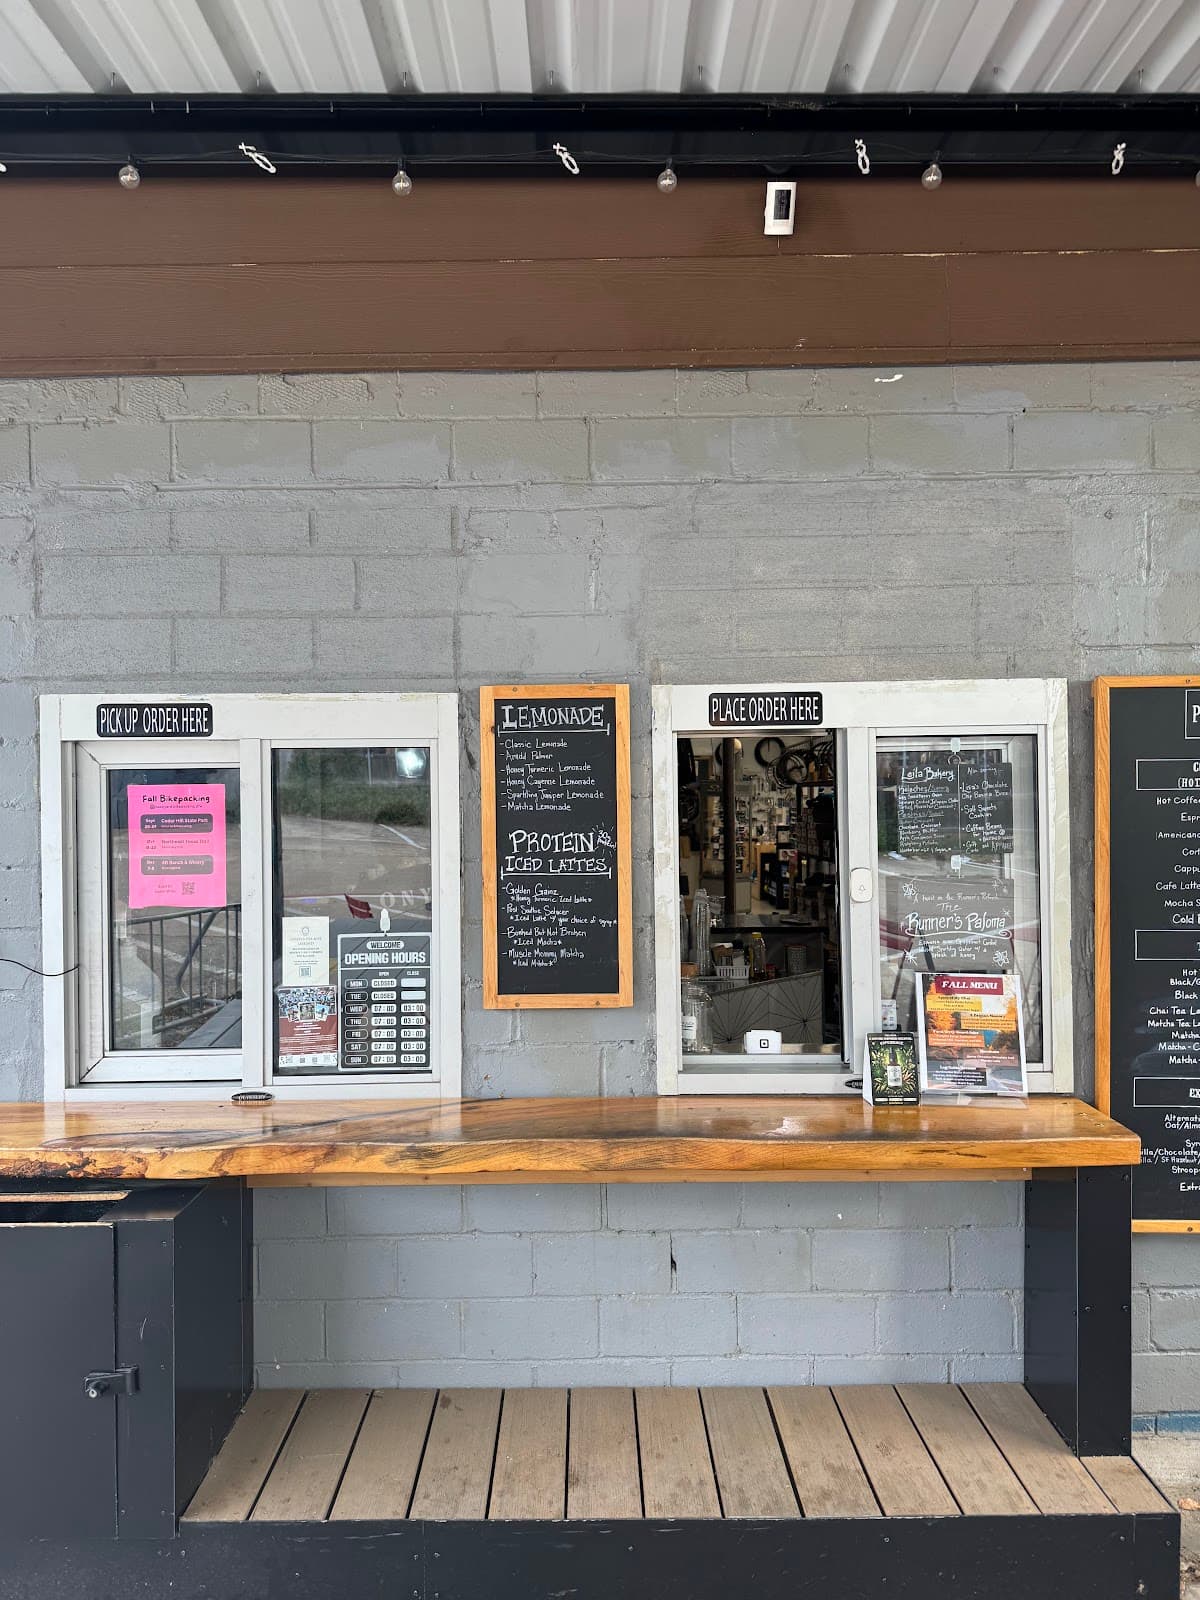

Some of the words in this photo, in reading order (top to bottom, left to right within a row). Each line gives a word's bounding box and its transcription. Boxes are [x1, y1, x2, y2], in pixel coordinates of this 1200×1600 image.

[712, 697, 746, 722] PLACE
[748, 697, 788, 721] ORDER
[790, 696, 819, 721] HERE
[100, 707, 122, 733] PICK
[124, 707, 138, 733] UP
[142, 707, 179, 733] ORDER
[181, 707, 209, 733] HERE
[501, 704, 604, 729] LEMONADE
[504, 739, 532, 749] Classic
[535, 738, 568, 749] Lemonade
[531, 750, 553, 760] Palmer
[505, 763, 525, 776] Honey
[525, 763, 555, 774] Turmeric
[558, 761, 592, 772] Lemonade
[923, 766, 956, 782] Bakery
[506, 776, 526, 789] Honey
[527, 775, 556, 788] Cayenne
[560, 775, 596, 787] Lemonade
[142, 794, 157, 803] Fall
[159, 794, 210, 804] Bikepacking
[507, 789, 538, 803] Sparkling
[566, 789, 605, 800] Lemonade
[1156, 796, 1171, 806] Hot
[507, 802, 534, 811] Matcha
[535, 802, 572, 811] Lemonade
[965, 823, 984, 833] Coffee
[509, 830, 595, 853] PROTEIN
[505, 856, 543, 872] ICED
[548, 858, 607, 873] LATTES
[506, 882, 531, 895] Golden
[514, 914, 530, 922] Iced
[570, 916, 588, 924] choice
[905, 911, 962, 931] Runner's
[965, 911, 1006, 931] Paloma
[1172, 913, 1195, 925] Cold
[534, 927, 545, 936] But
[546, 927, 558, 936] Not
[560, 927, 587, 937] Broken
[370, 941, 401, 949] WELCOME
[517, 938, 534, 946] Iced
[344, 952, 389, 965] OPENING
[391, 951, 426, 964] HOURS
[508, 949, 532, 961] Muscle
[534, 949, 558, 963] Mommy
[1182, 969, 1197, 977] Hot
[941, 981, 969, 989] FALL
[969, 981, 998, 990] MENU
[1174, 989, 1199, 1000] Black
[1149, 1006, 1169, 1016] Chai
[1171, 1005, 1187, 1015] Tea
[1147, 1019, 1175, 1028] Matcha
[1176, 1018, 1191, 1028] Tea
